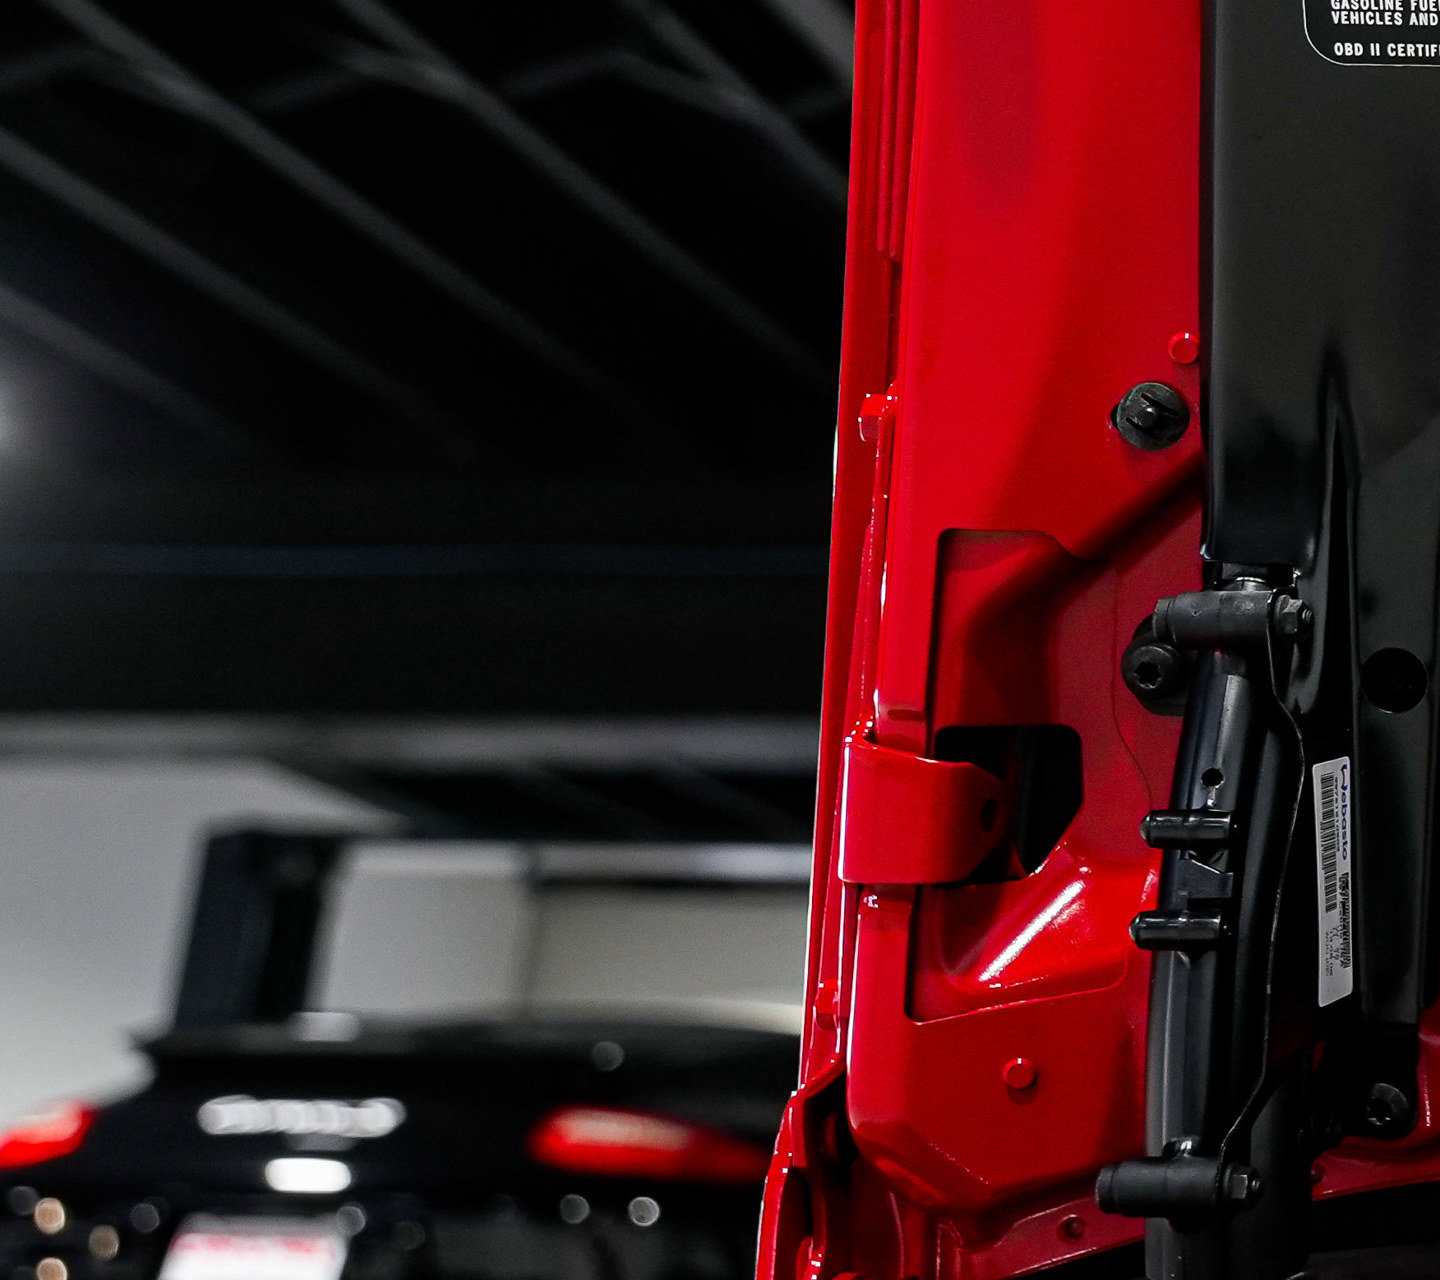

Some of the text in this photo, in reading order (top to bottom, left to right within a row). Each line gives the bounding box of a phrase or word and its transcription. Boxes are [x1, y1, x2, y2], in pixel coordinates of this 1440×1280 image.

[1331, 11, 1403, 25] VEHICLES
[1409, 12, 1438, 26] AND
[1334, 42, 1363, 56] OBD
[1370, 43, 1380, 56] II
